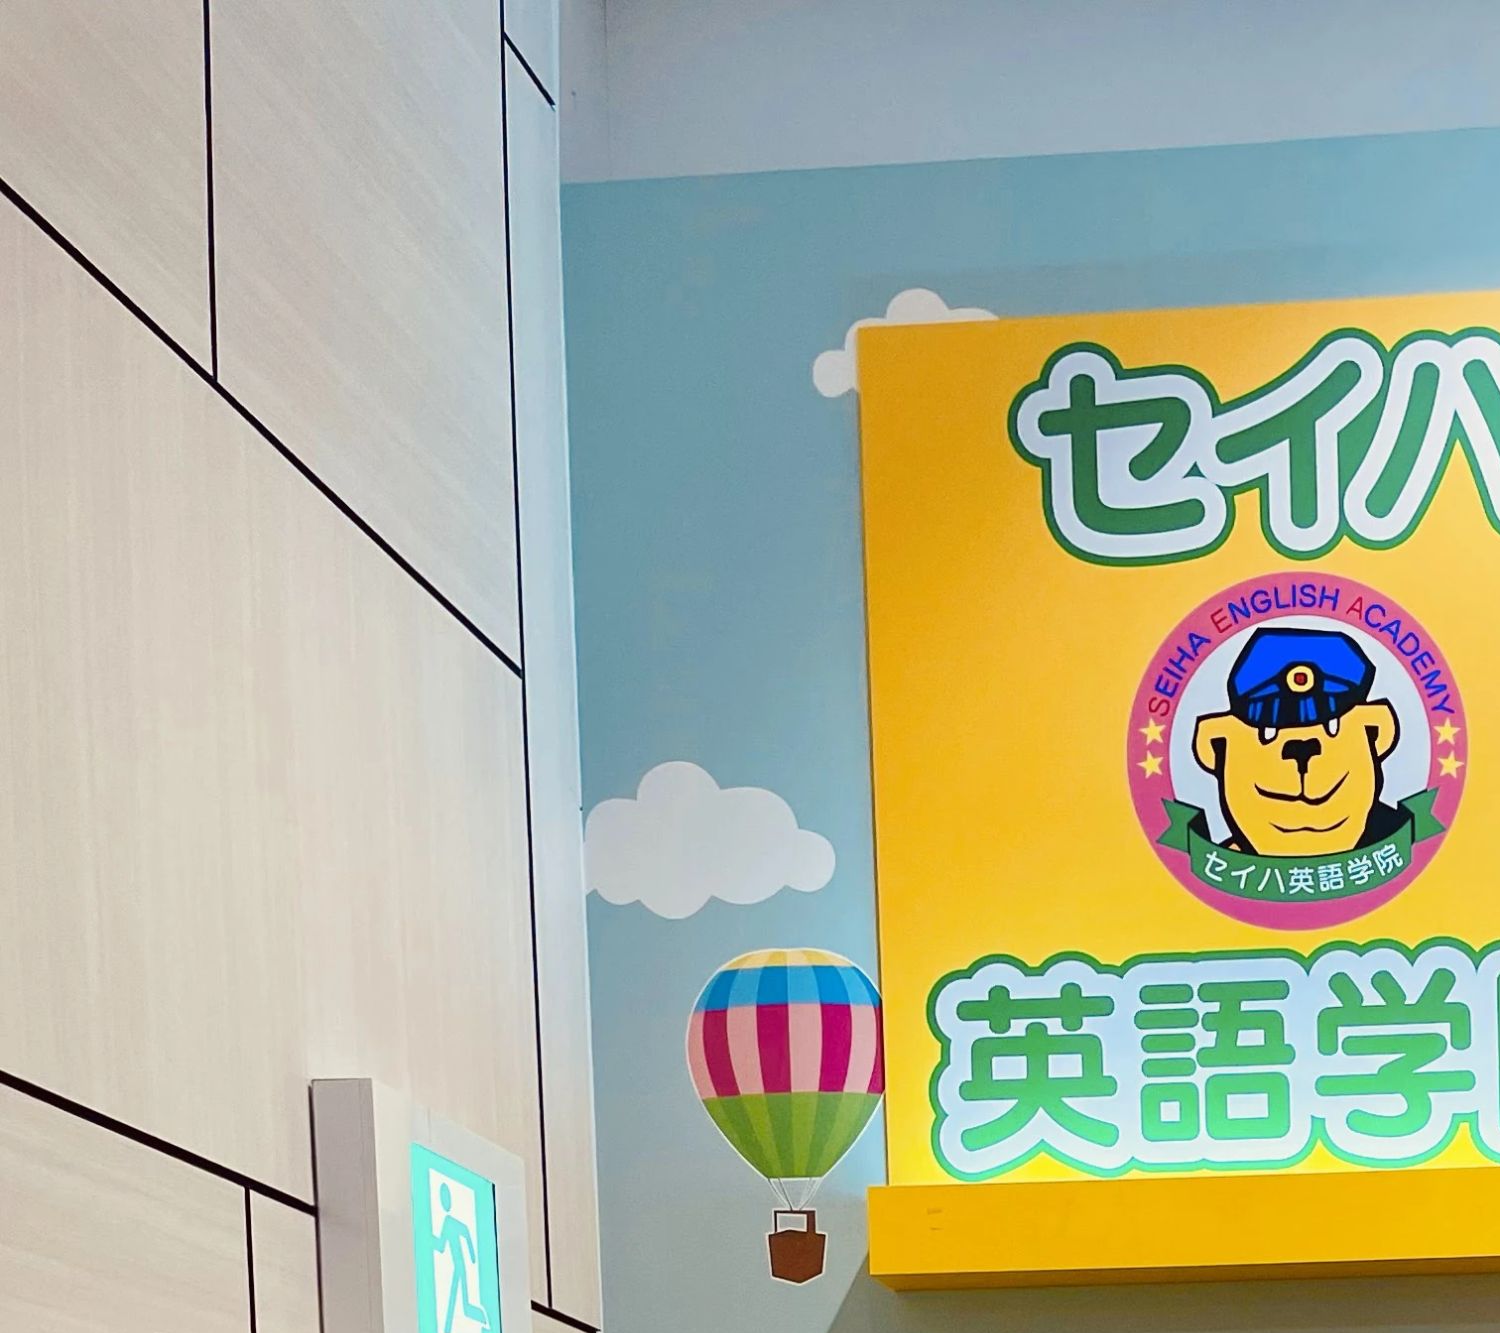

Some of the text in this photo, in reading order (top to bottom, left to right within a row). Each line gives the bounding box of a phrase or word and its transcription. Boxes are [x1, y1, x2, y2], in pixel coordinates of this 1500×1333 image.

[1149, 584, 1455, 717] SEIHA ENGLISH ACADEMY
[1204, 844, 1403, 895] セイハ英語学院
